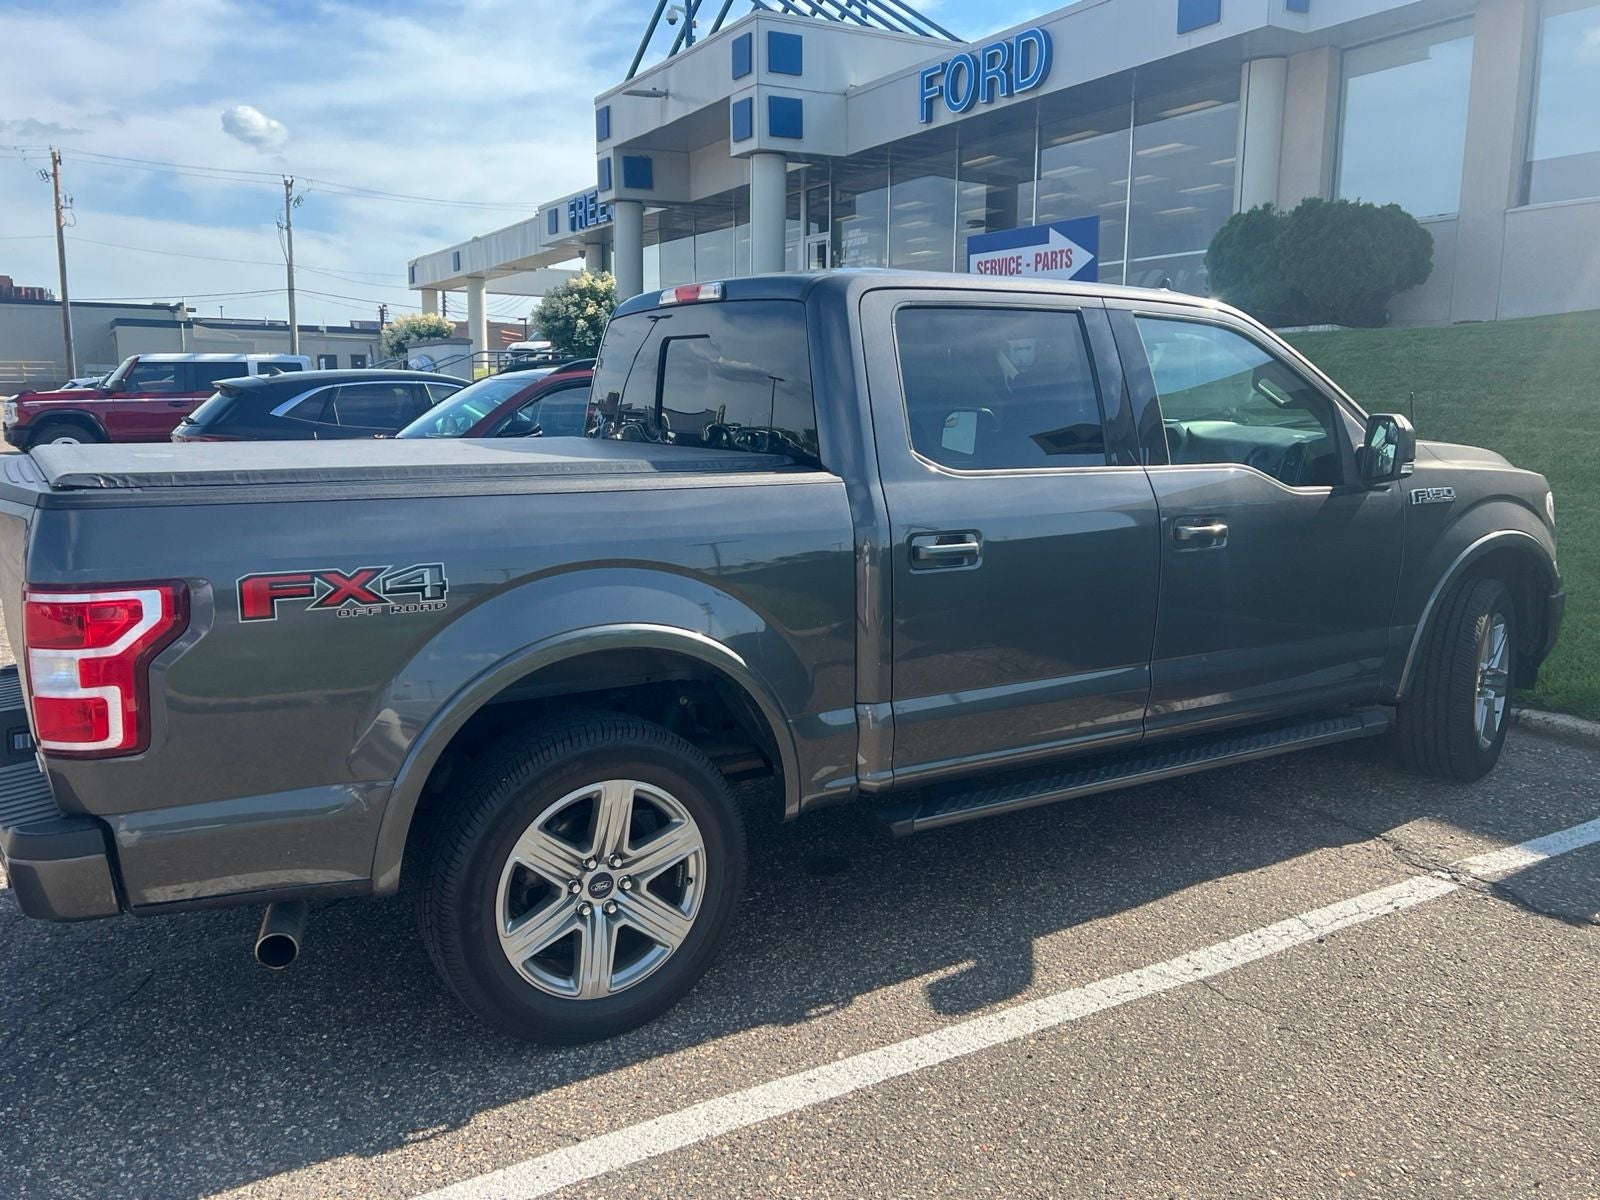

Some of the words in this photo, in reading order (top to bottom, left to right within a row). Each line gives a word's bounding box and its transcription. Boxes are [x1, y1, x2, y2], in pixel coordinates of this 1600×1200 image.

[919, 27, 1053, 123] FORD
[976, 255, 1023, 276] SERVICE
[1034, 247, 1073, 272] PARTS
[236, 562, 449, 623] FX4
[337, 605, 382, 618] OFF
[390, 602, 447, 615] ROAD
